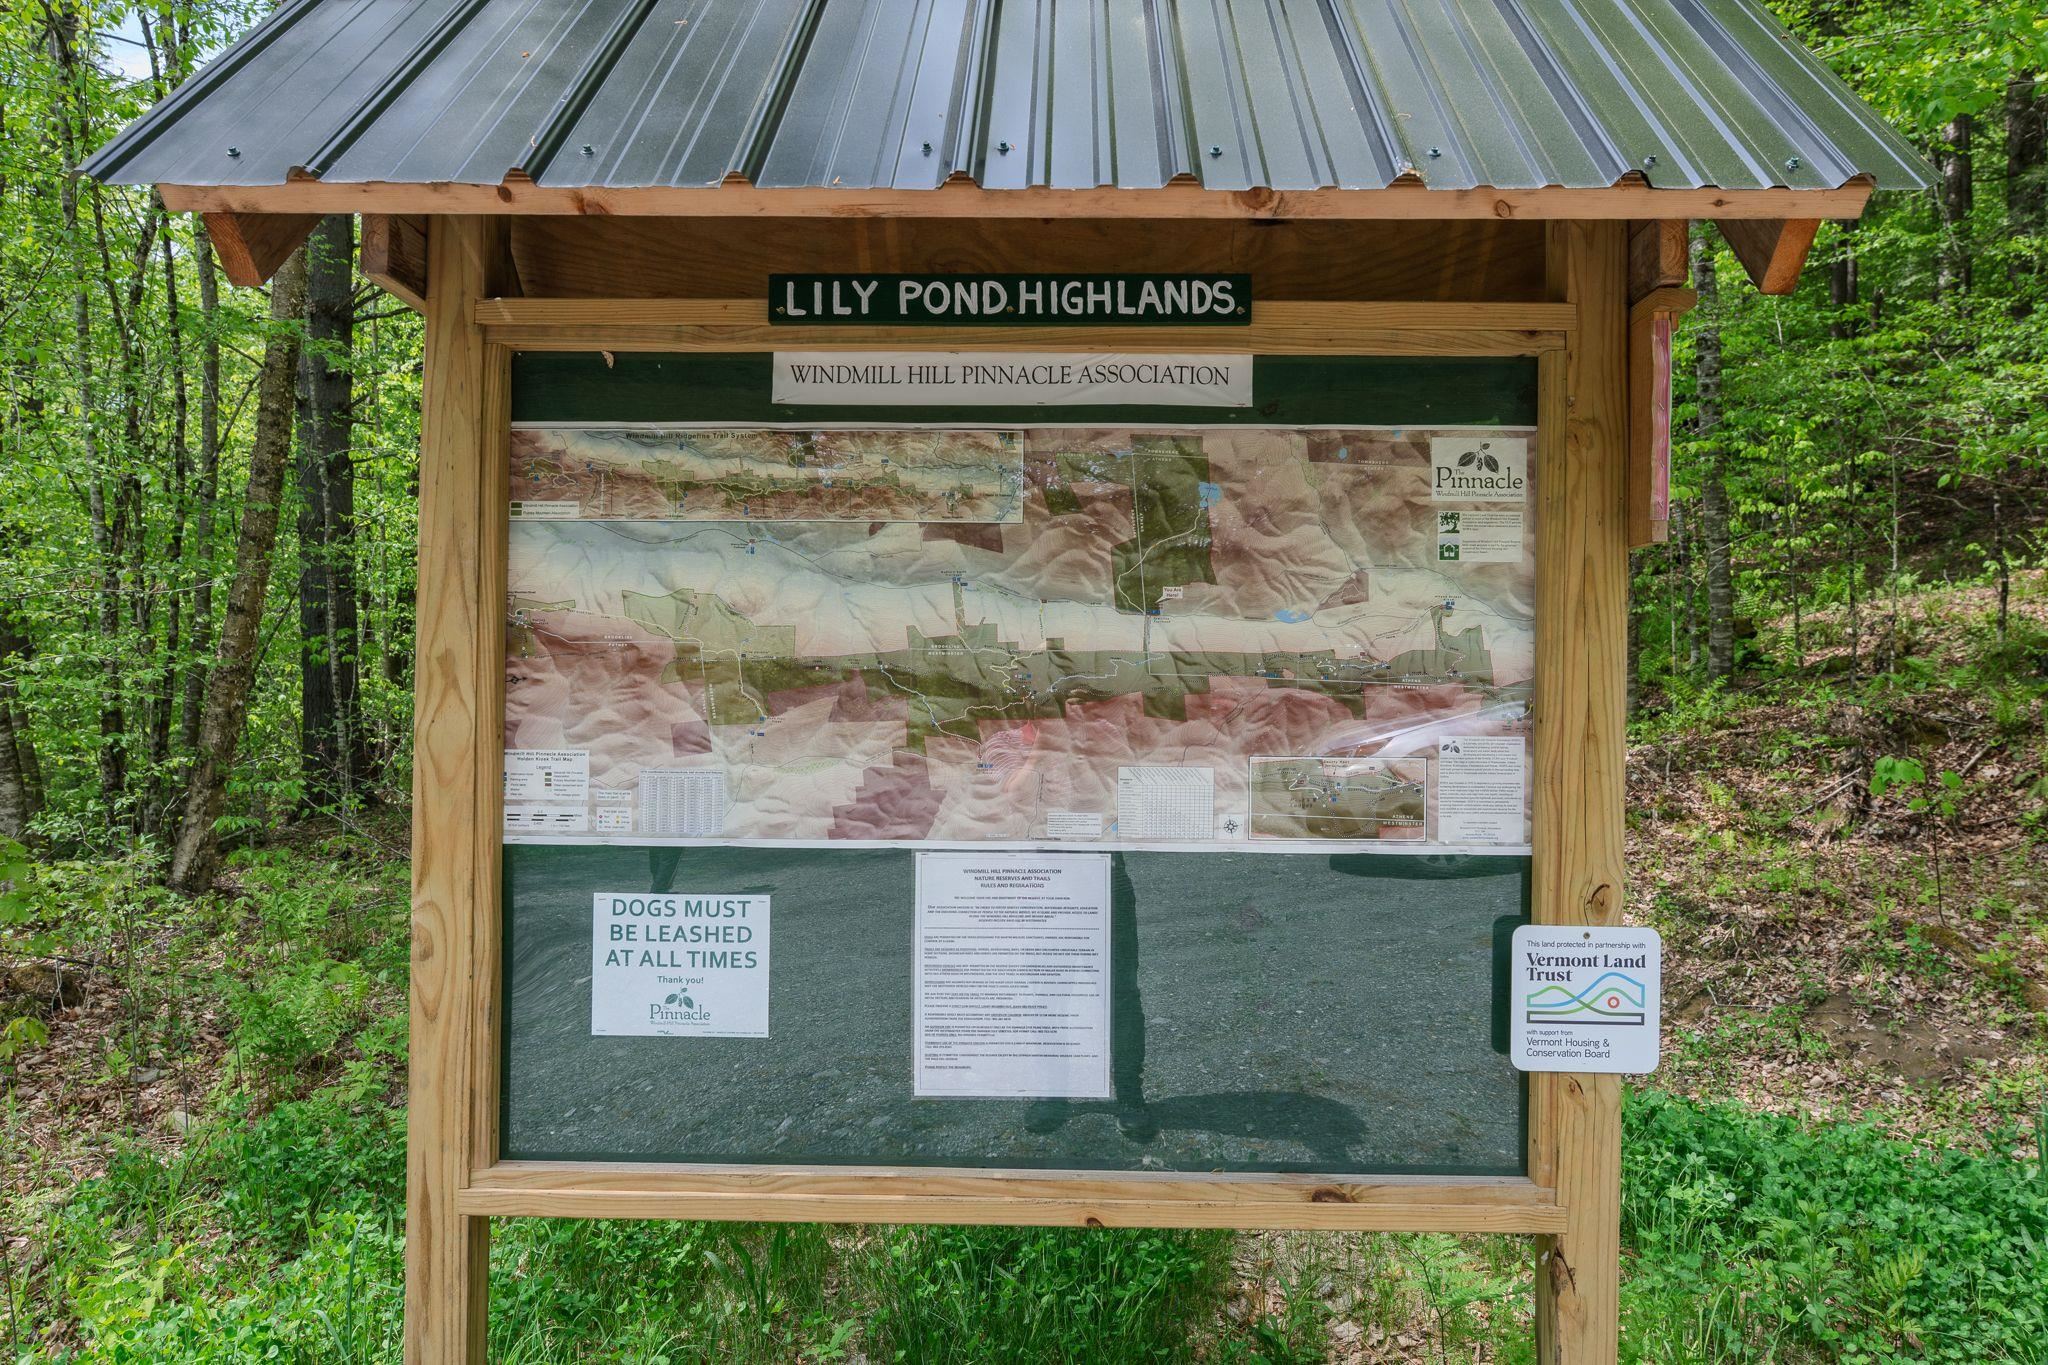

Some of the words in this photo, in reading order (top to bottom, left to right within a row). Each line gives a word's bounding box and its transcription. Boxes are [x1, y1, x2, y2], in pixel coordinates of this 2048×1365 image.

[786, 281, 878, 316] LILY
[899, 280, 1007, 315] POND
[1018, 280, 1236, 315] HIGHLANDS
[790, 364, 902, 384] WINDMILL
[908, 364, 956, 384] HILL
[961, 365, 1072, 385] PINNACLE
[1077, 363, 1230, 385] ASSOCIATION
[730, 432, 758, 441] System
[1436, 466, 1523, 489] Pinnacle
[612, 898, 676, 917] DOGS
[684, 900, 751, 918] MUST
[610, 924, 638, 942] BE
[645, 925, 753, 943] LEASHED
[1541, 940, 1555, 948] land
[1556, 941, 1586, 949] protected
[1595, 942, 1631, 950] partnership
[605, 949, 634, 967] AT
[639, 950, 682, 968] ALL
[686, 951, 758, 969] TIMES
[1527, 953, 1599, 968] Vermont
[1603, 954, 1646, 968] Land
[657, 976, 684, 984] Thank
[685, 976, 704, 985] you!
[1527, 967, 1573, 982] Trust
[650, 1003, 711, 1021] Pinnacle
[1526, 1037, 1563, 1047] Vermont
[1565, 1037, 1600, 1049] Housing
[1602, 1039, 1610, 1047] &
[1526, 1047, 1582, 1058] Conservation
[1584, 1049, 1610, 1058] Board
